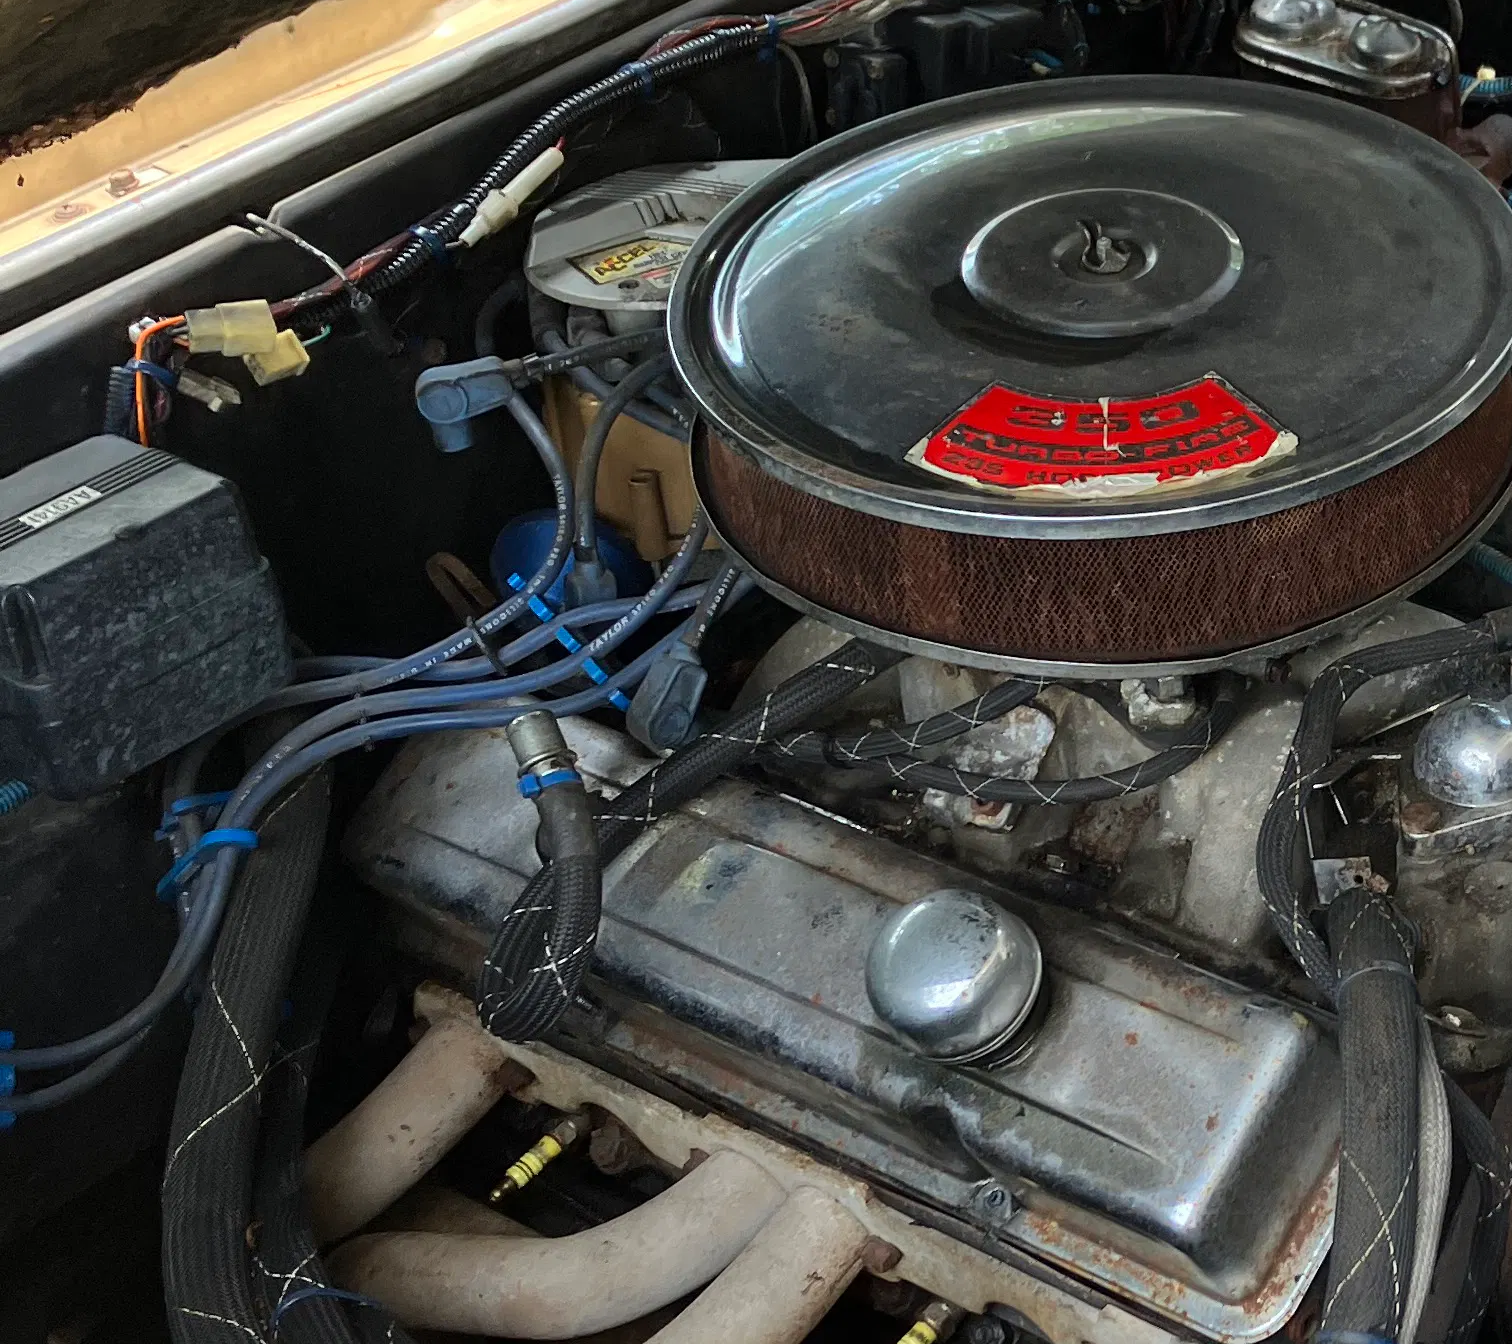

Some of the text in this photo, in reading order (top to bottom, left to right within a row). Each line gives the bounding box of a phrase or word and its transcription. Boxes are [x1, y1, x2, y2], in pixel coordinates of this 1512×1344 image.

[593, 243, 658, 277] ACCEL
[1005, 402, 1200, 433] 350
[946, 414, 1264, 466] TURBO-FIRE
